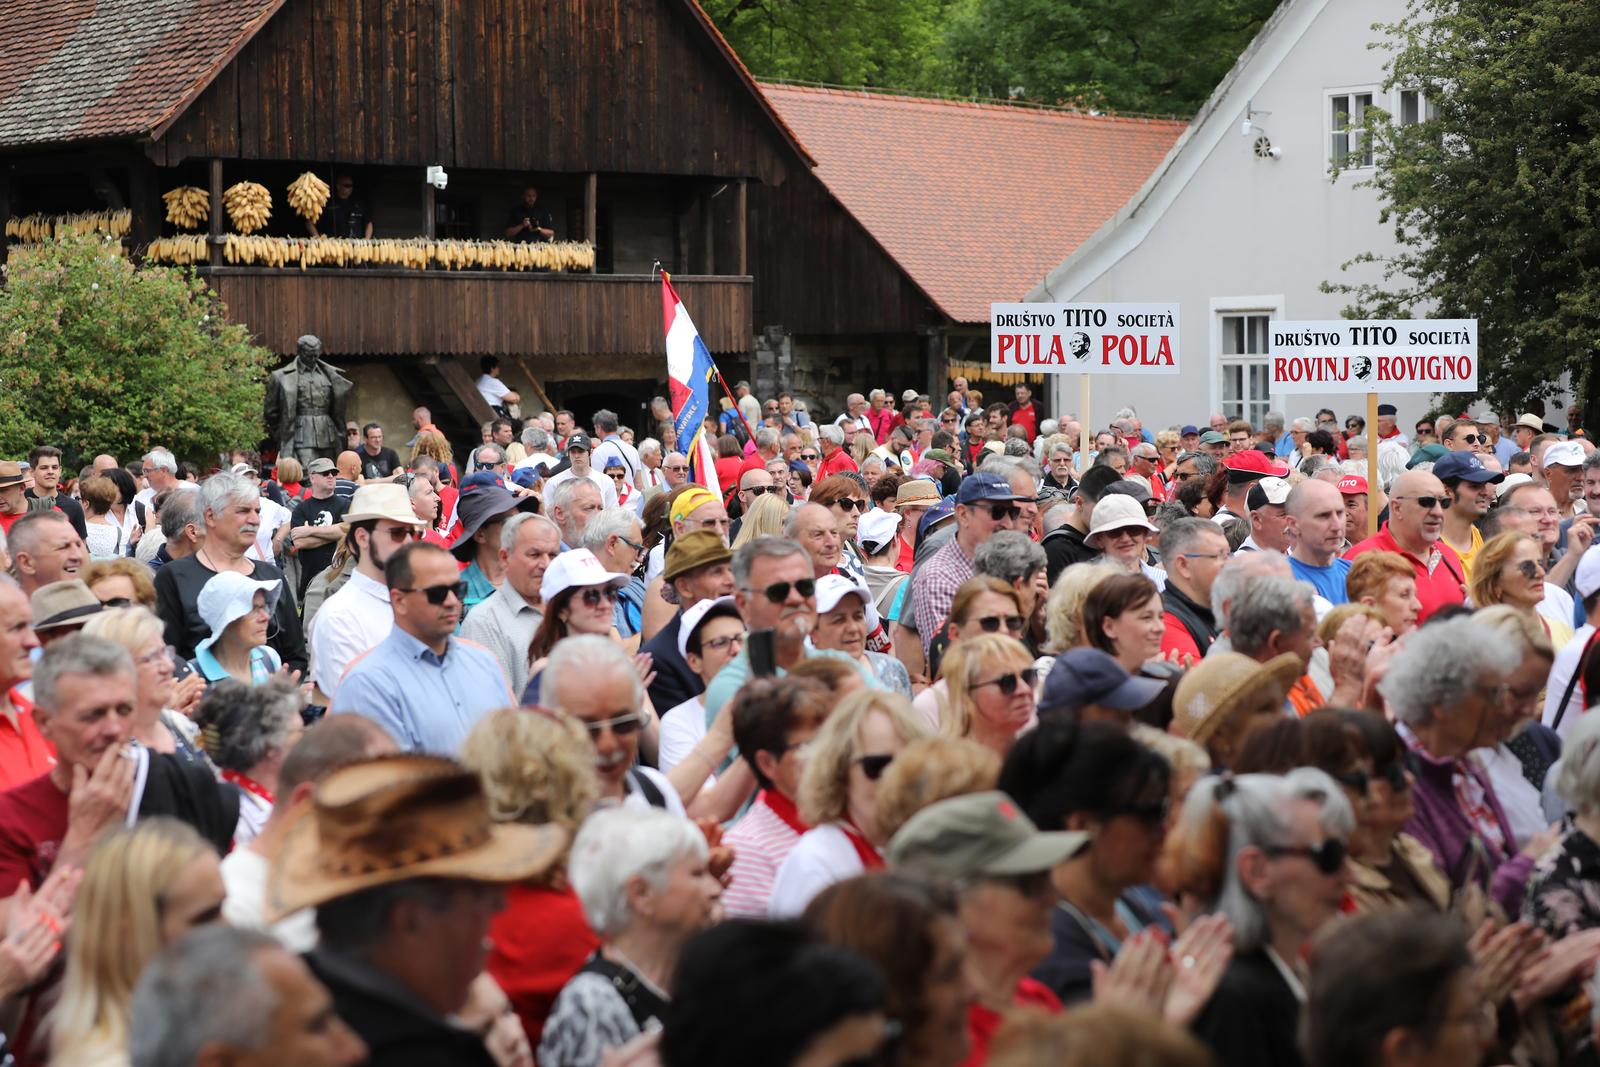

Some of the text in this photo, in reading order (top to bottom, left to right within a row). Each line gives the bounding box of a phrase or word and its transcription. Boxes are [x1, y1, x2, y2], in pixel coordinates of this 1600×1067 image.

[996, 308, 1175, 327] DRUŠTVO TITO SOCIETÀ
[1274, 326, 1471, 347] DRUŠTVO TITO SOCIETÀ
[997, 334, 1175, 366] PULA POLA
[1274, 355, 1472, 382] ROVINJ ROVIGNO
